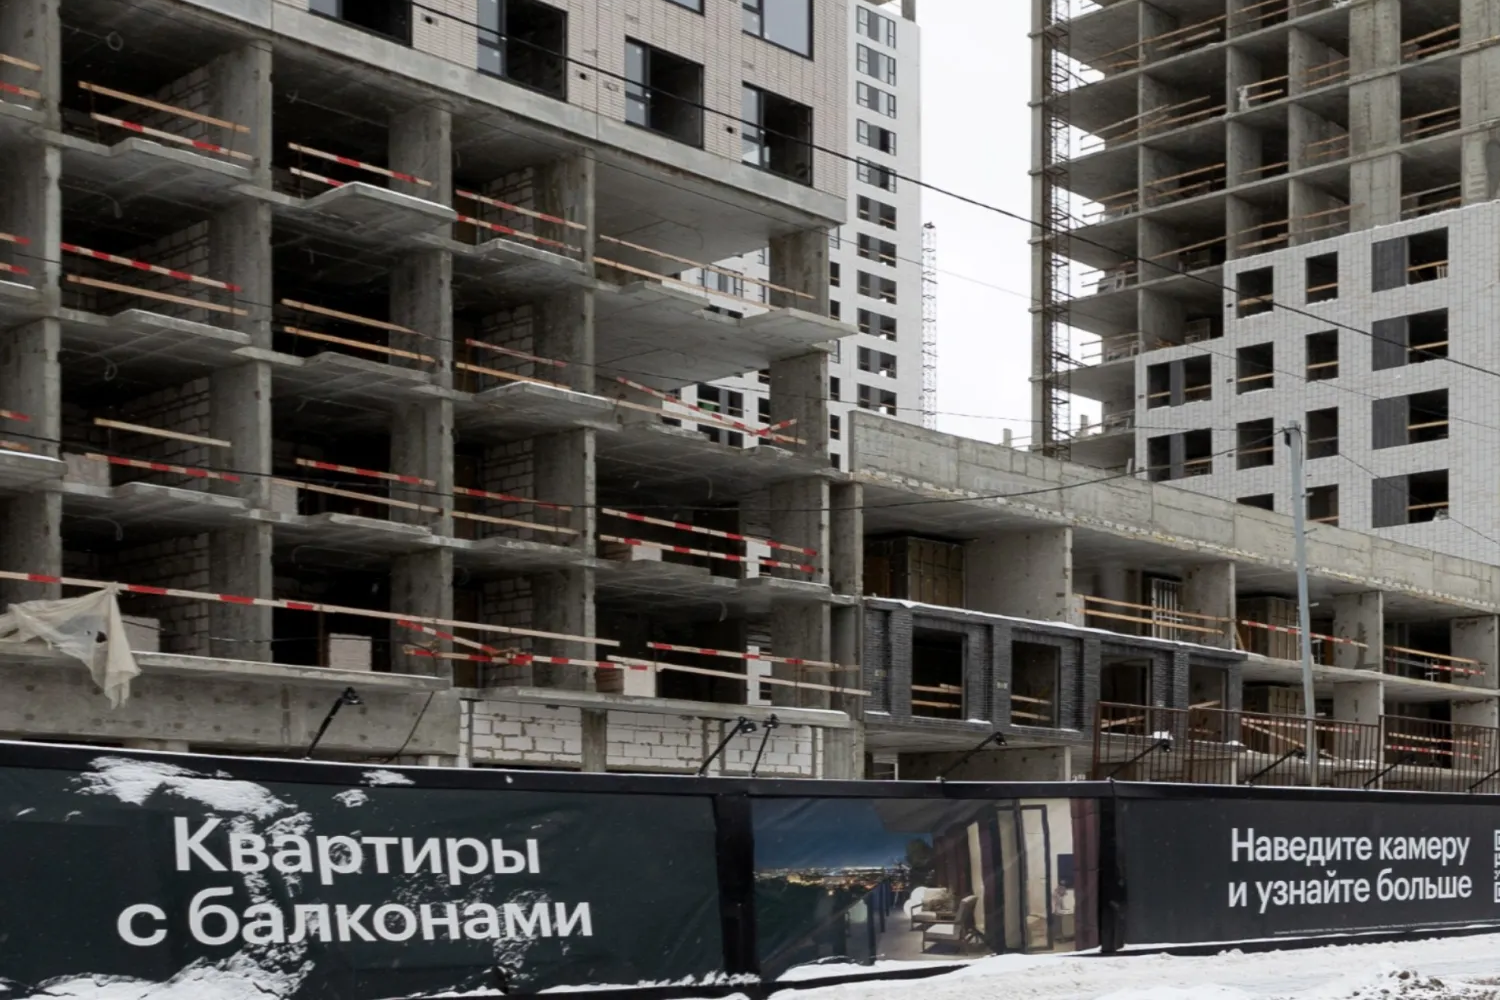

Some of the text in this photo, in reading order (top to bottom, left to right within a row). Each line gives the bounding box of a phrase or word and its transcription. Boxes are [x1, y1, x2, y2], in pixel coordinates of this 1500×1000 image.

[173, 816, 541, 885] Квартиры
[1231, 827, 1470, 866] Наведите камеру
[117, 887, 593, 947] с балконами
[1228, 868, 1472, 914] и узнайте больше
